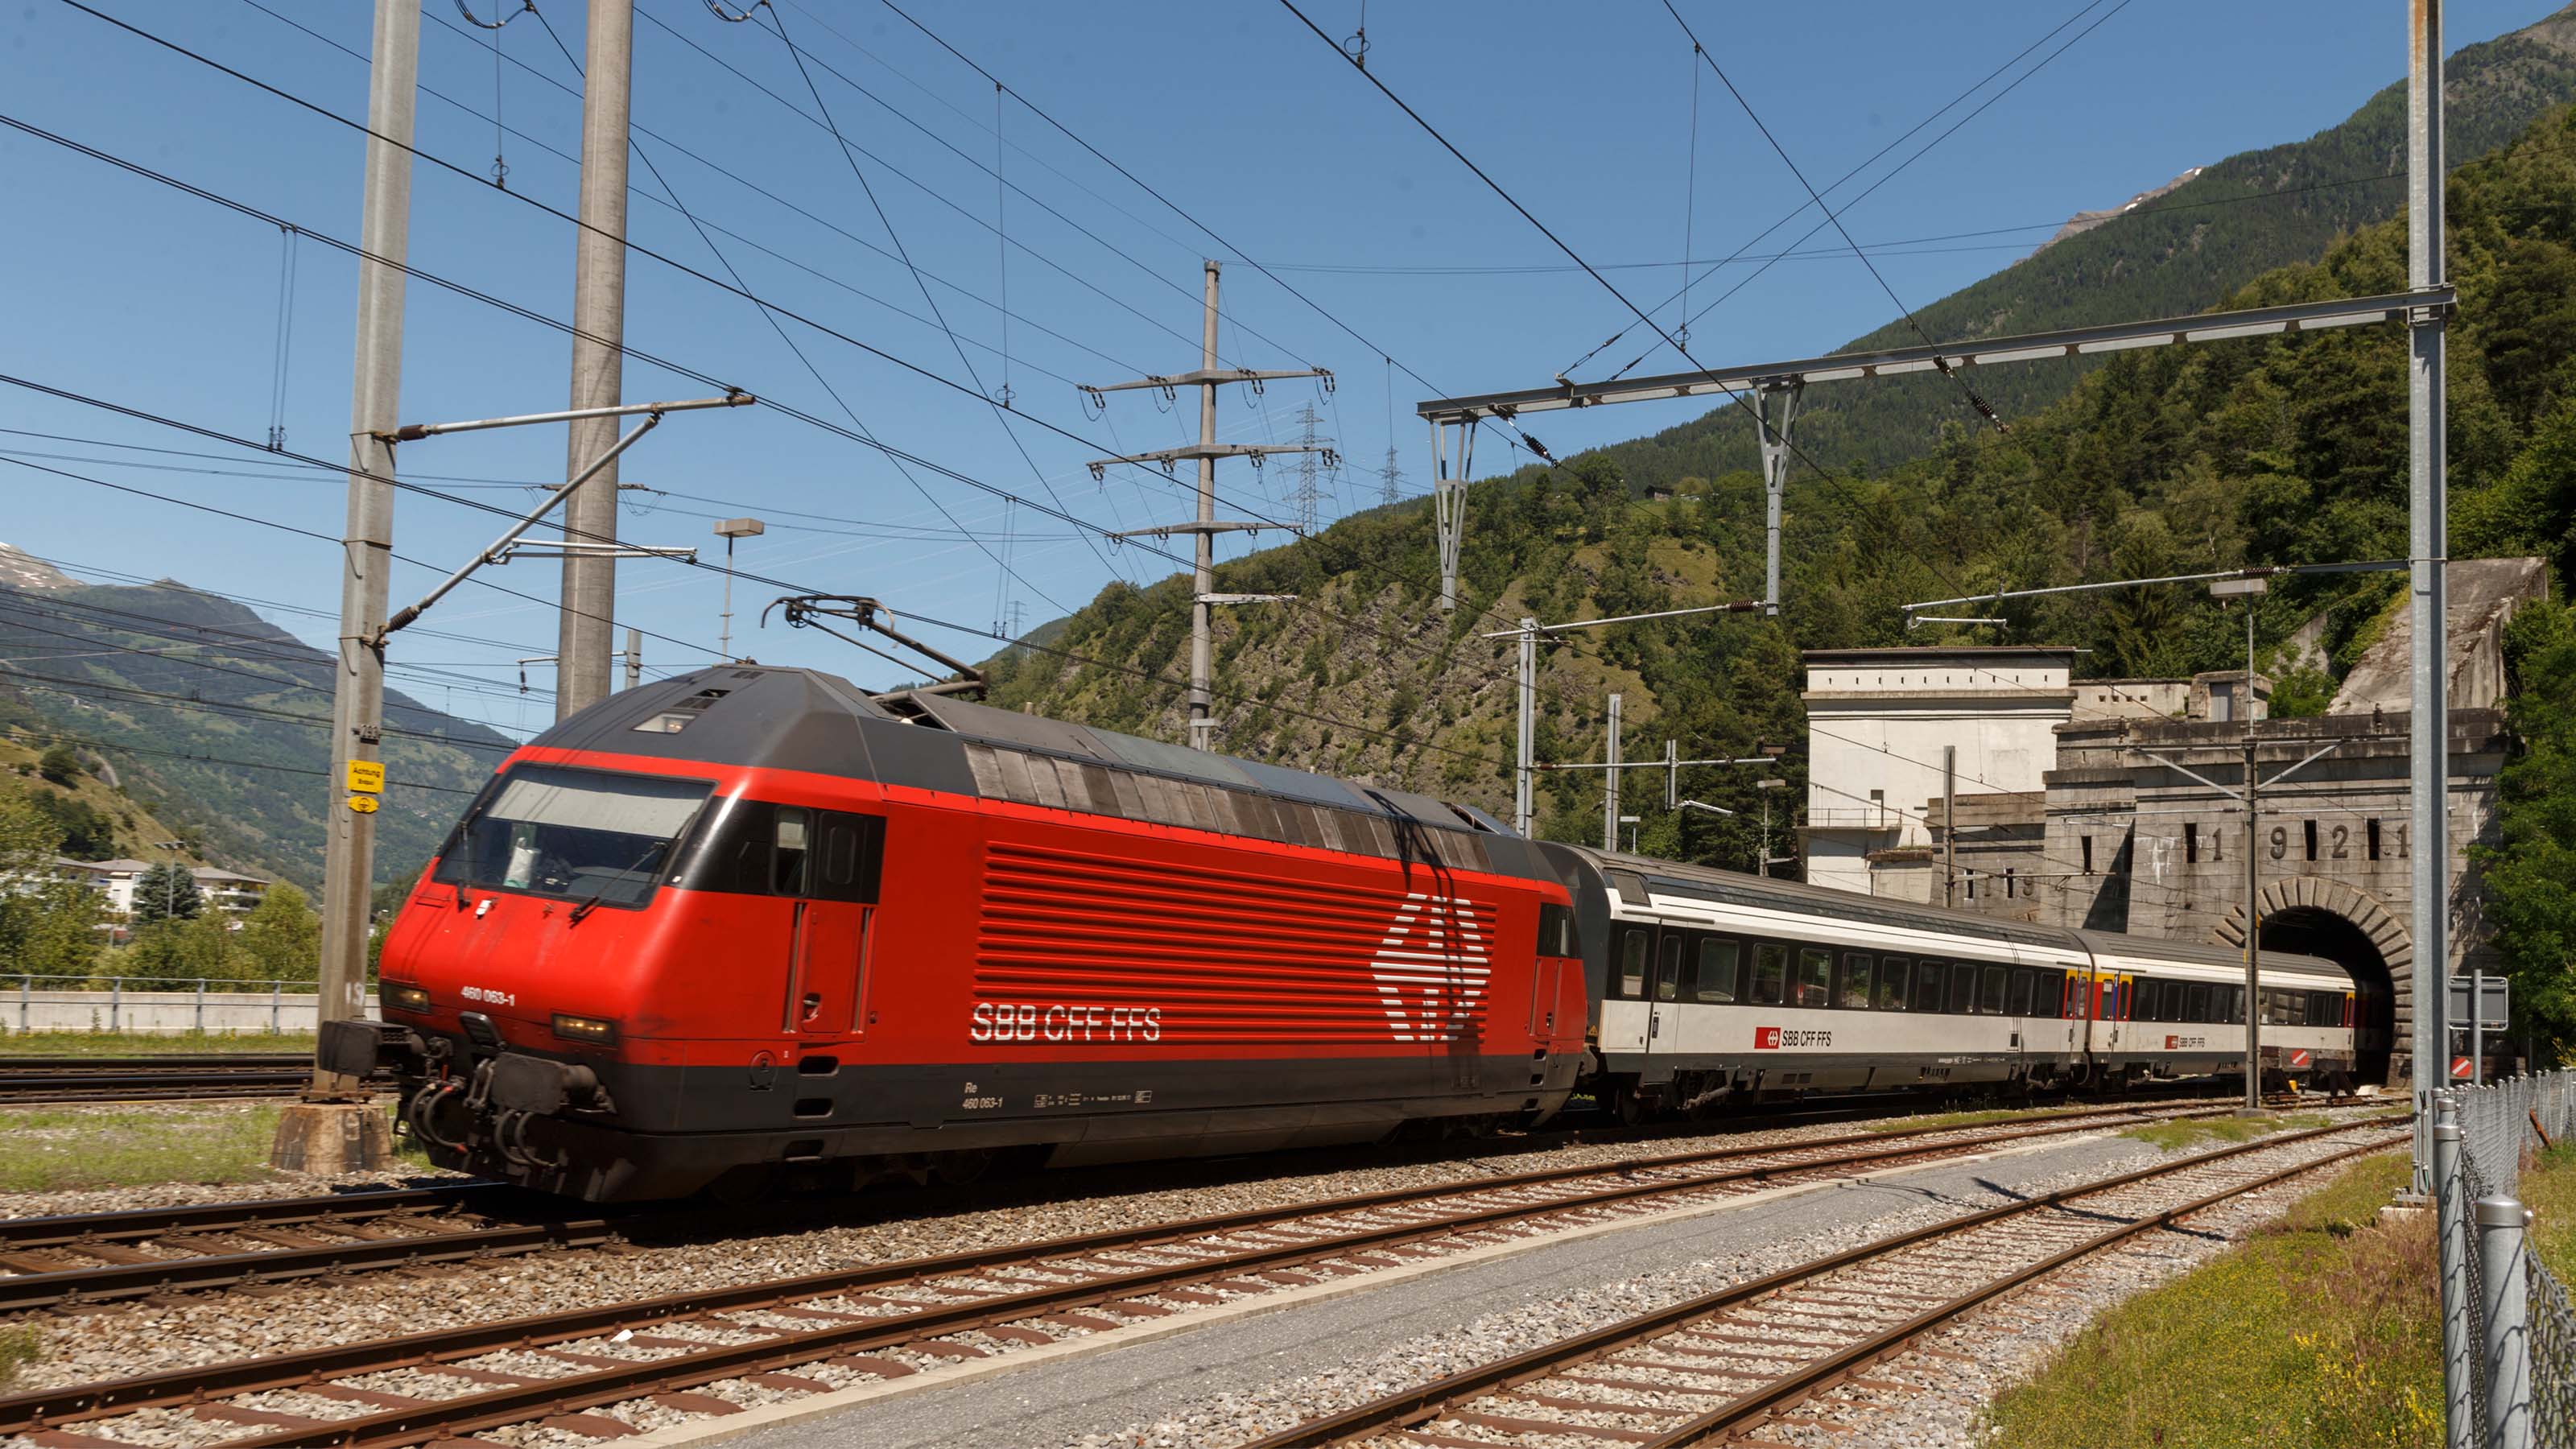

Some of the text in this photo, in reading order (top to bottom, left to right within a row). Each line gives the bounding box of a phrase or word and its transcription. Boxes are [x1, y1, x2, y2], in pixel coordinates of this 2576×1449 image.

[971, 1002, 1161, 1042] SBB CFF FFS
[1781, 1030, 1832, 1047] SBB CFF FFS
[964, 1082, 978, 1094] Re
[962, 1096, 1003, 1109] 460 063-1
